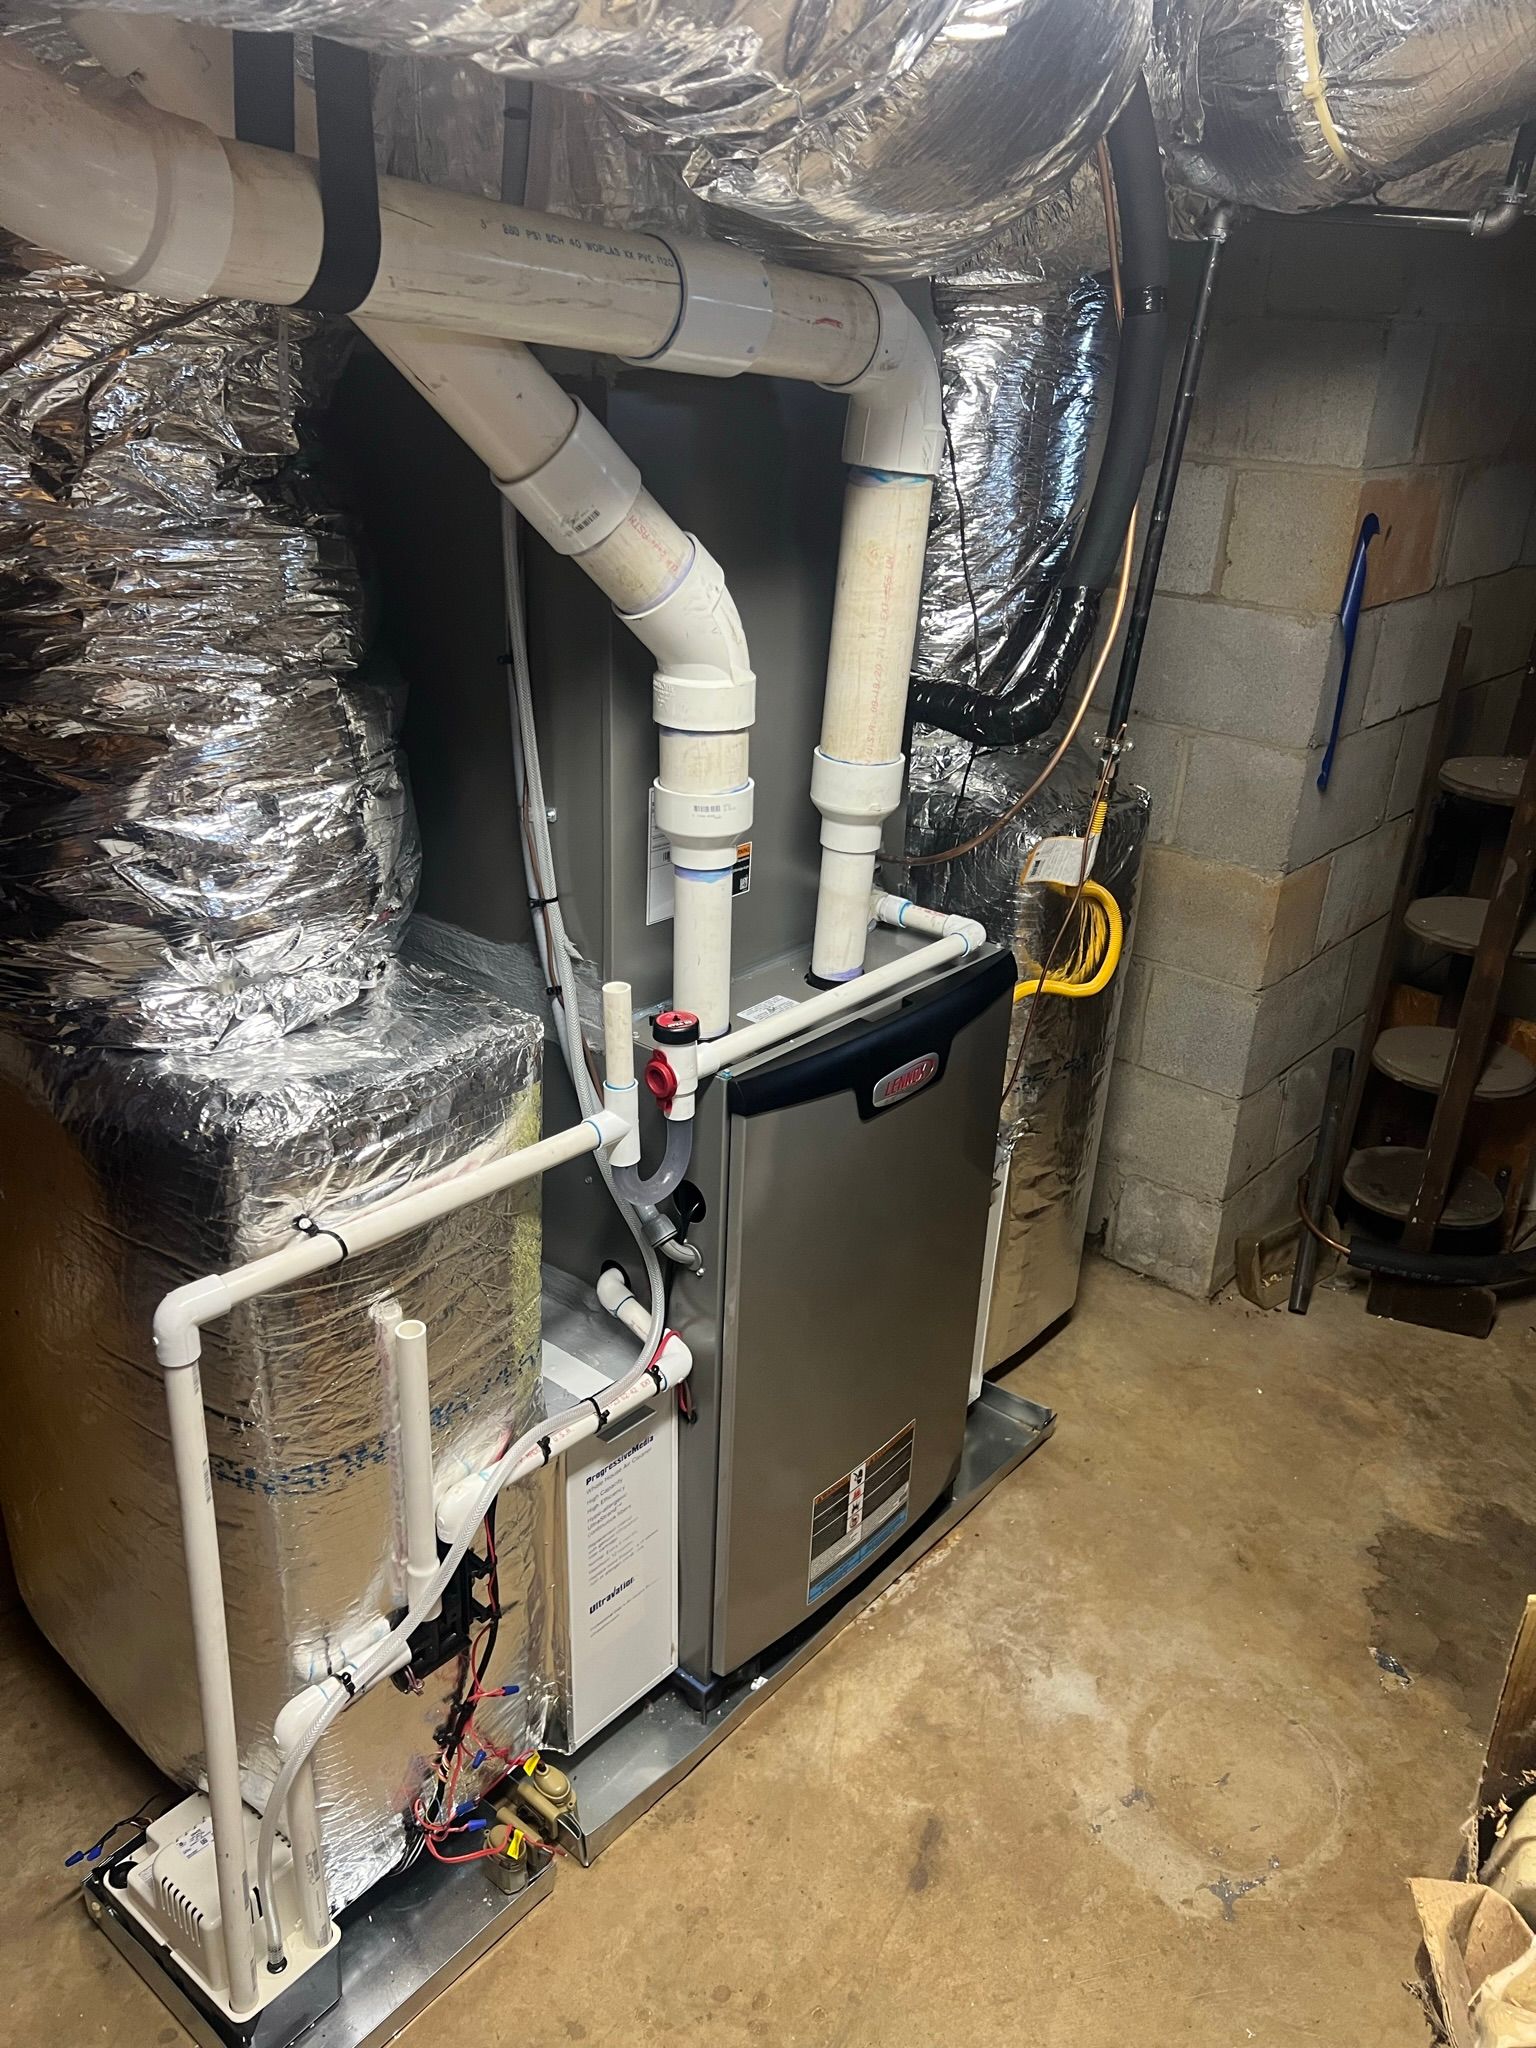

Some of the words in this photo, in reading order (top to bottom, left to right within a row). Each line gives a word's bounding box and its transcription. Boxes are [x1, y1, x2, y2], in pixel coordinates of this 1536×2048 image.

[637, 252, 655, 265] PVC
[884, 1062, 928, 1097] LENNOX
[586, 1435, 654, 1486] ProgressiveMedia
